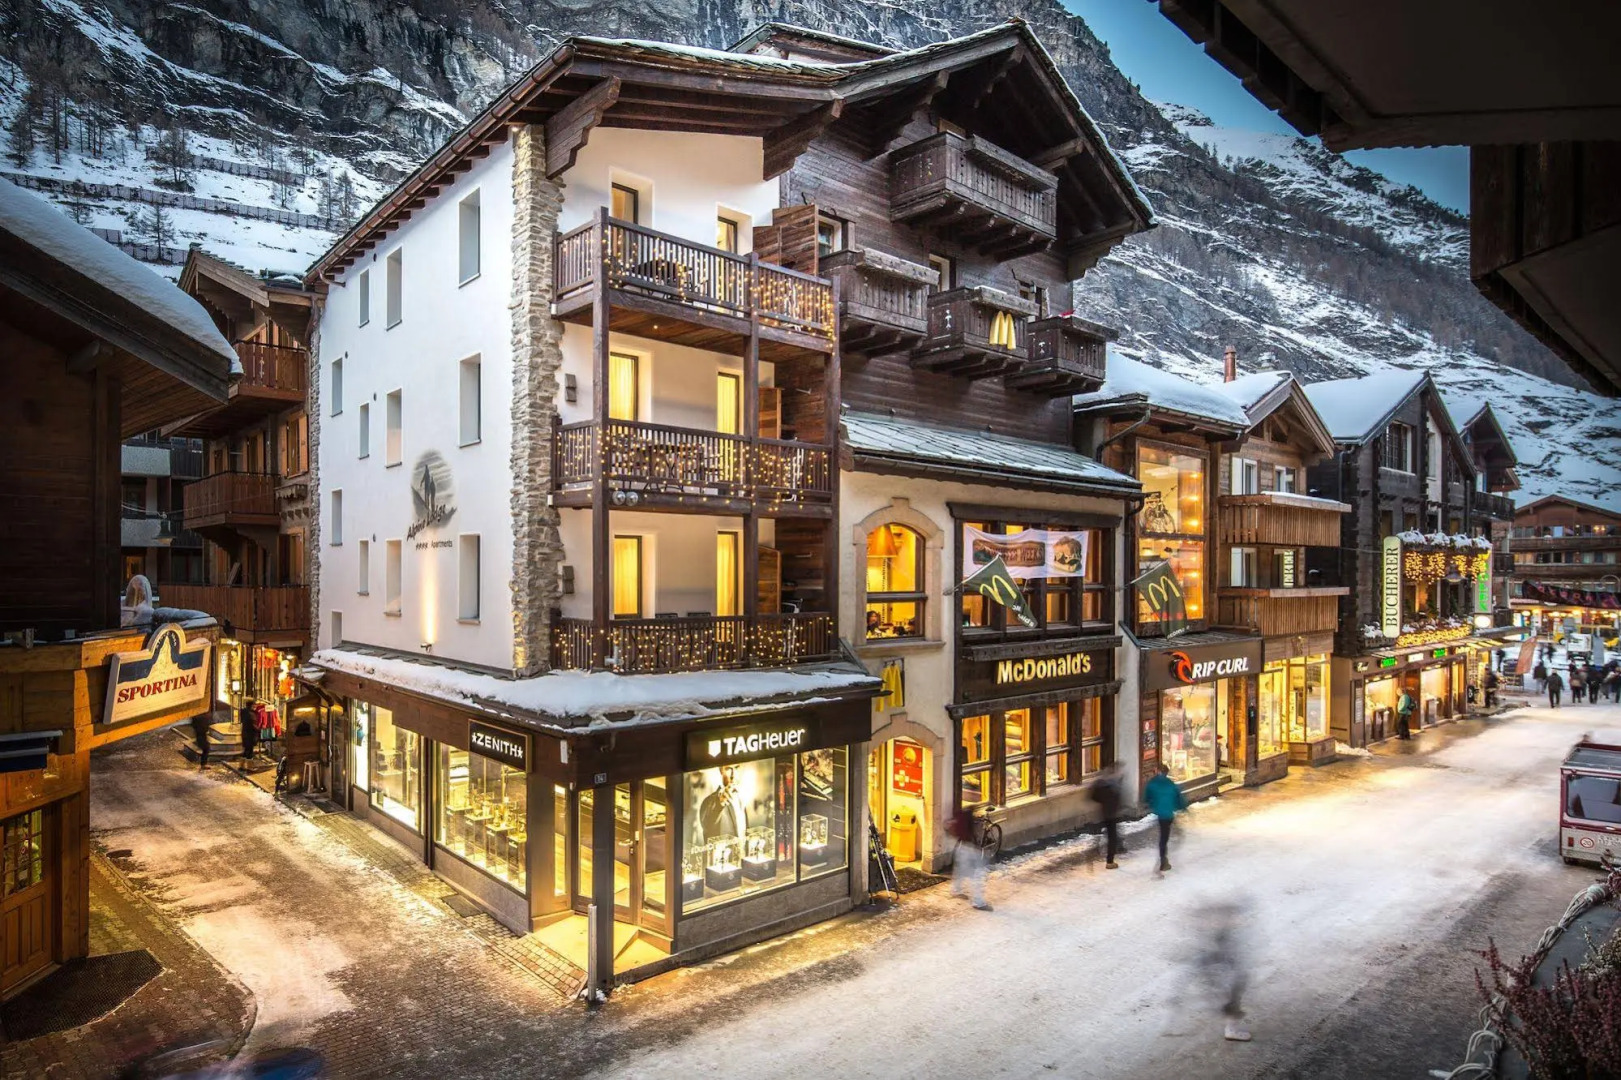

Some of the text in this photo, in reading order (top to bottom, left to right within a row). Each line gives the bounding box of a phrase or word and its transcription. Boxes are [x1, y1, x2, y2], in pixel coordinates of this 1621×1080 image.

[406, 504, 446, 542] Alpine Lodge
[431, 540, 453, 548] Apartments
[1385, 547, 1398, 627] BUCHERER
[996, 652, 1092, 685] McDonald's
[1192, 656, 1249, 679] RIP CURL
[117, 673, 197, 704] SPORTINA
[476, 732, 518, 757] ZENITH
